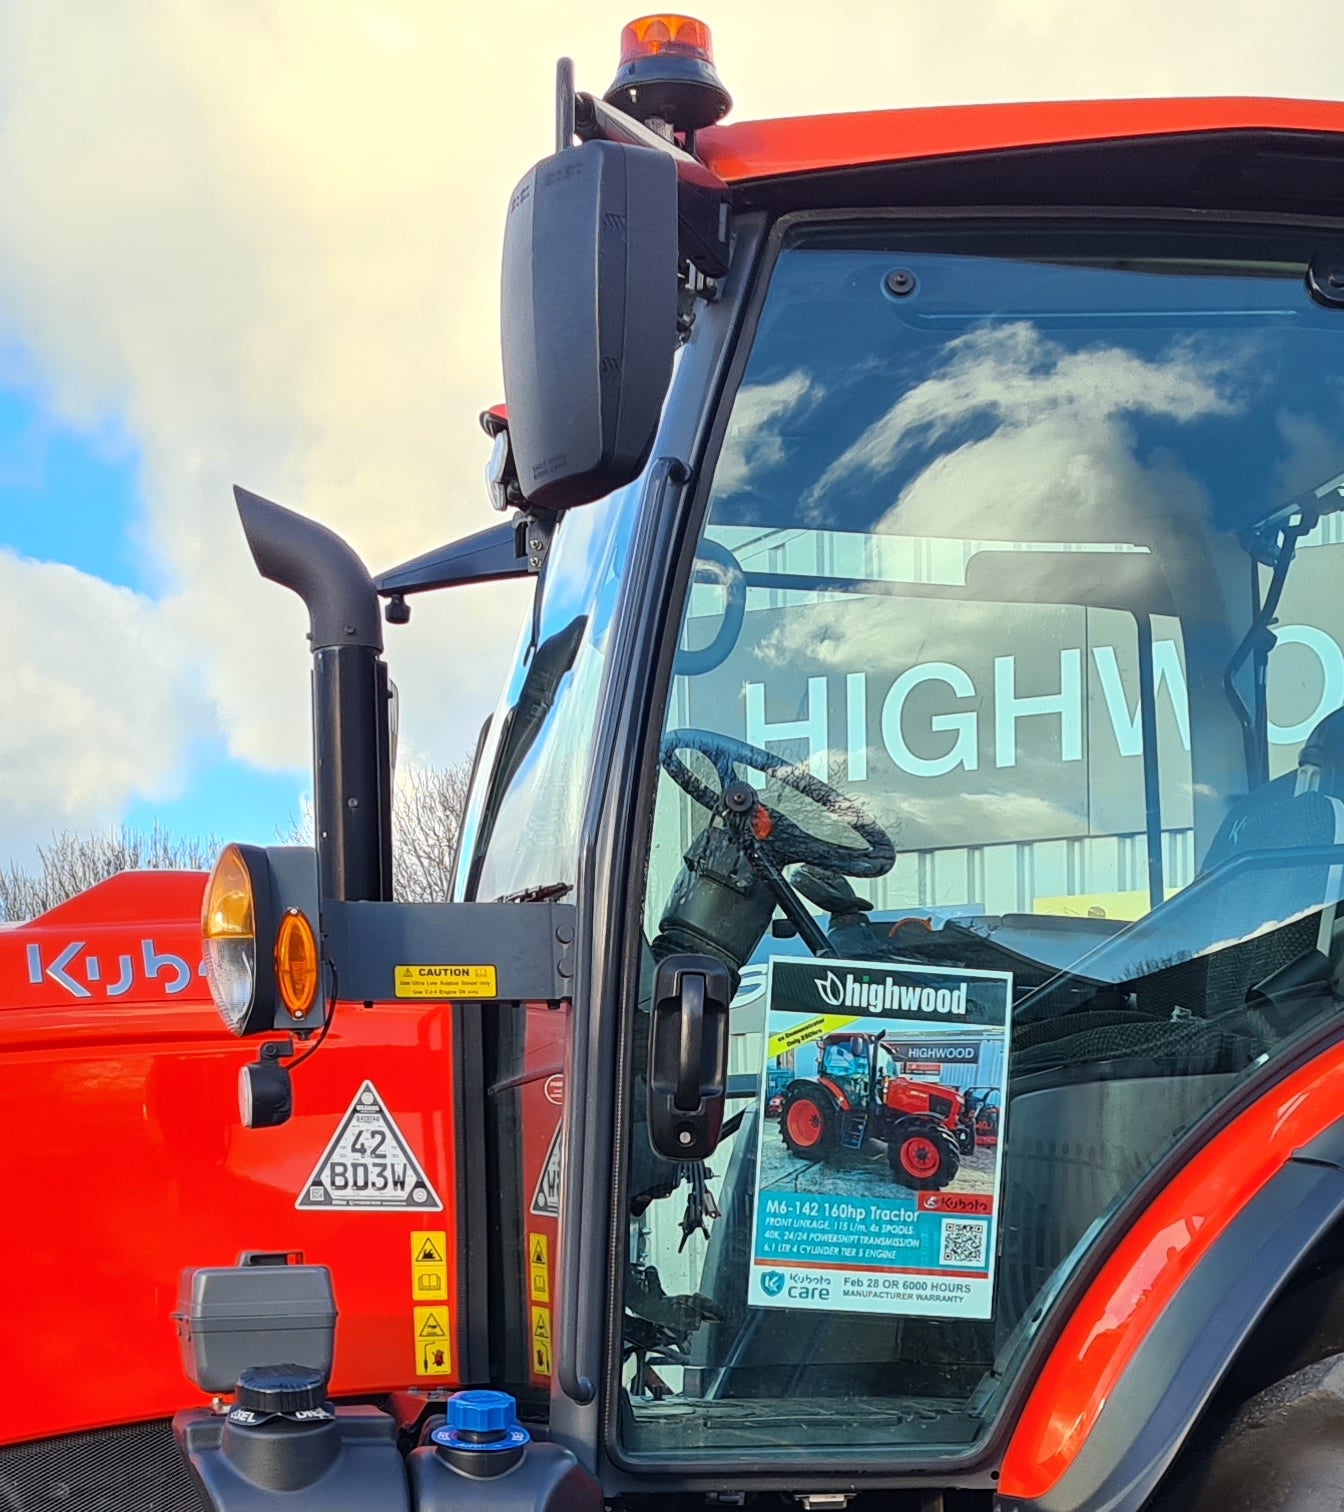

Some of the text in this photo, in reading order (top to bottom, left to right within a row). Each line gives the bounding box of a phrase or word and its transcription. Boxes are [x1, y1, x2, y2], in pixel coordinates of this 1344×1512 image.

[26, 938, 207, 998] Kub
[418, 968, 470, 977] CAUTION
[845, 974, 968, 1014] highwood
[908, 1047, 975, 1060] HIGHWOOD
[351, 1130, 387, 1159] 42
[329, 1161, 407, 1192] BD3W
[766, 1200, 919, 1222] M6-142 160hp Tractor
[941, 1197, 988, 1211] Kubota
[765, 1217, 792, 1227] FRONT
[808, 1233, 859, 1244] POWERSHIFT
[860, 1236, 920, 1248] TRANSMISSION
[799, 1246, 840, 1256] CYLINDER
[865, 1249, 897, 1259] ENGINE
[790, 1272, 831, 1285] Kubota
[844, 1277, 972, 1293] Feb 28 OR 6000 HOURS
[787, 1286, 830, 1300] care
[843, 1289, 965, 1303] MANUFACTURER WARRANTY
